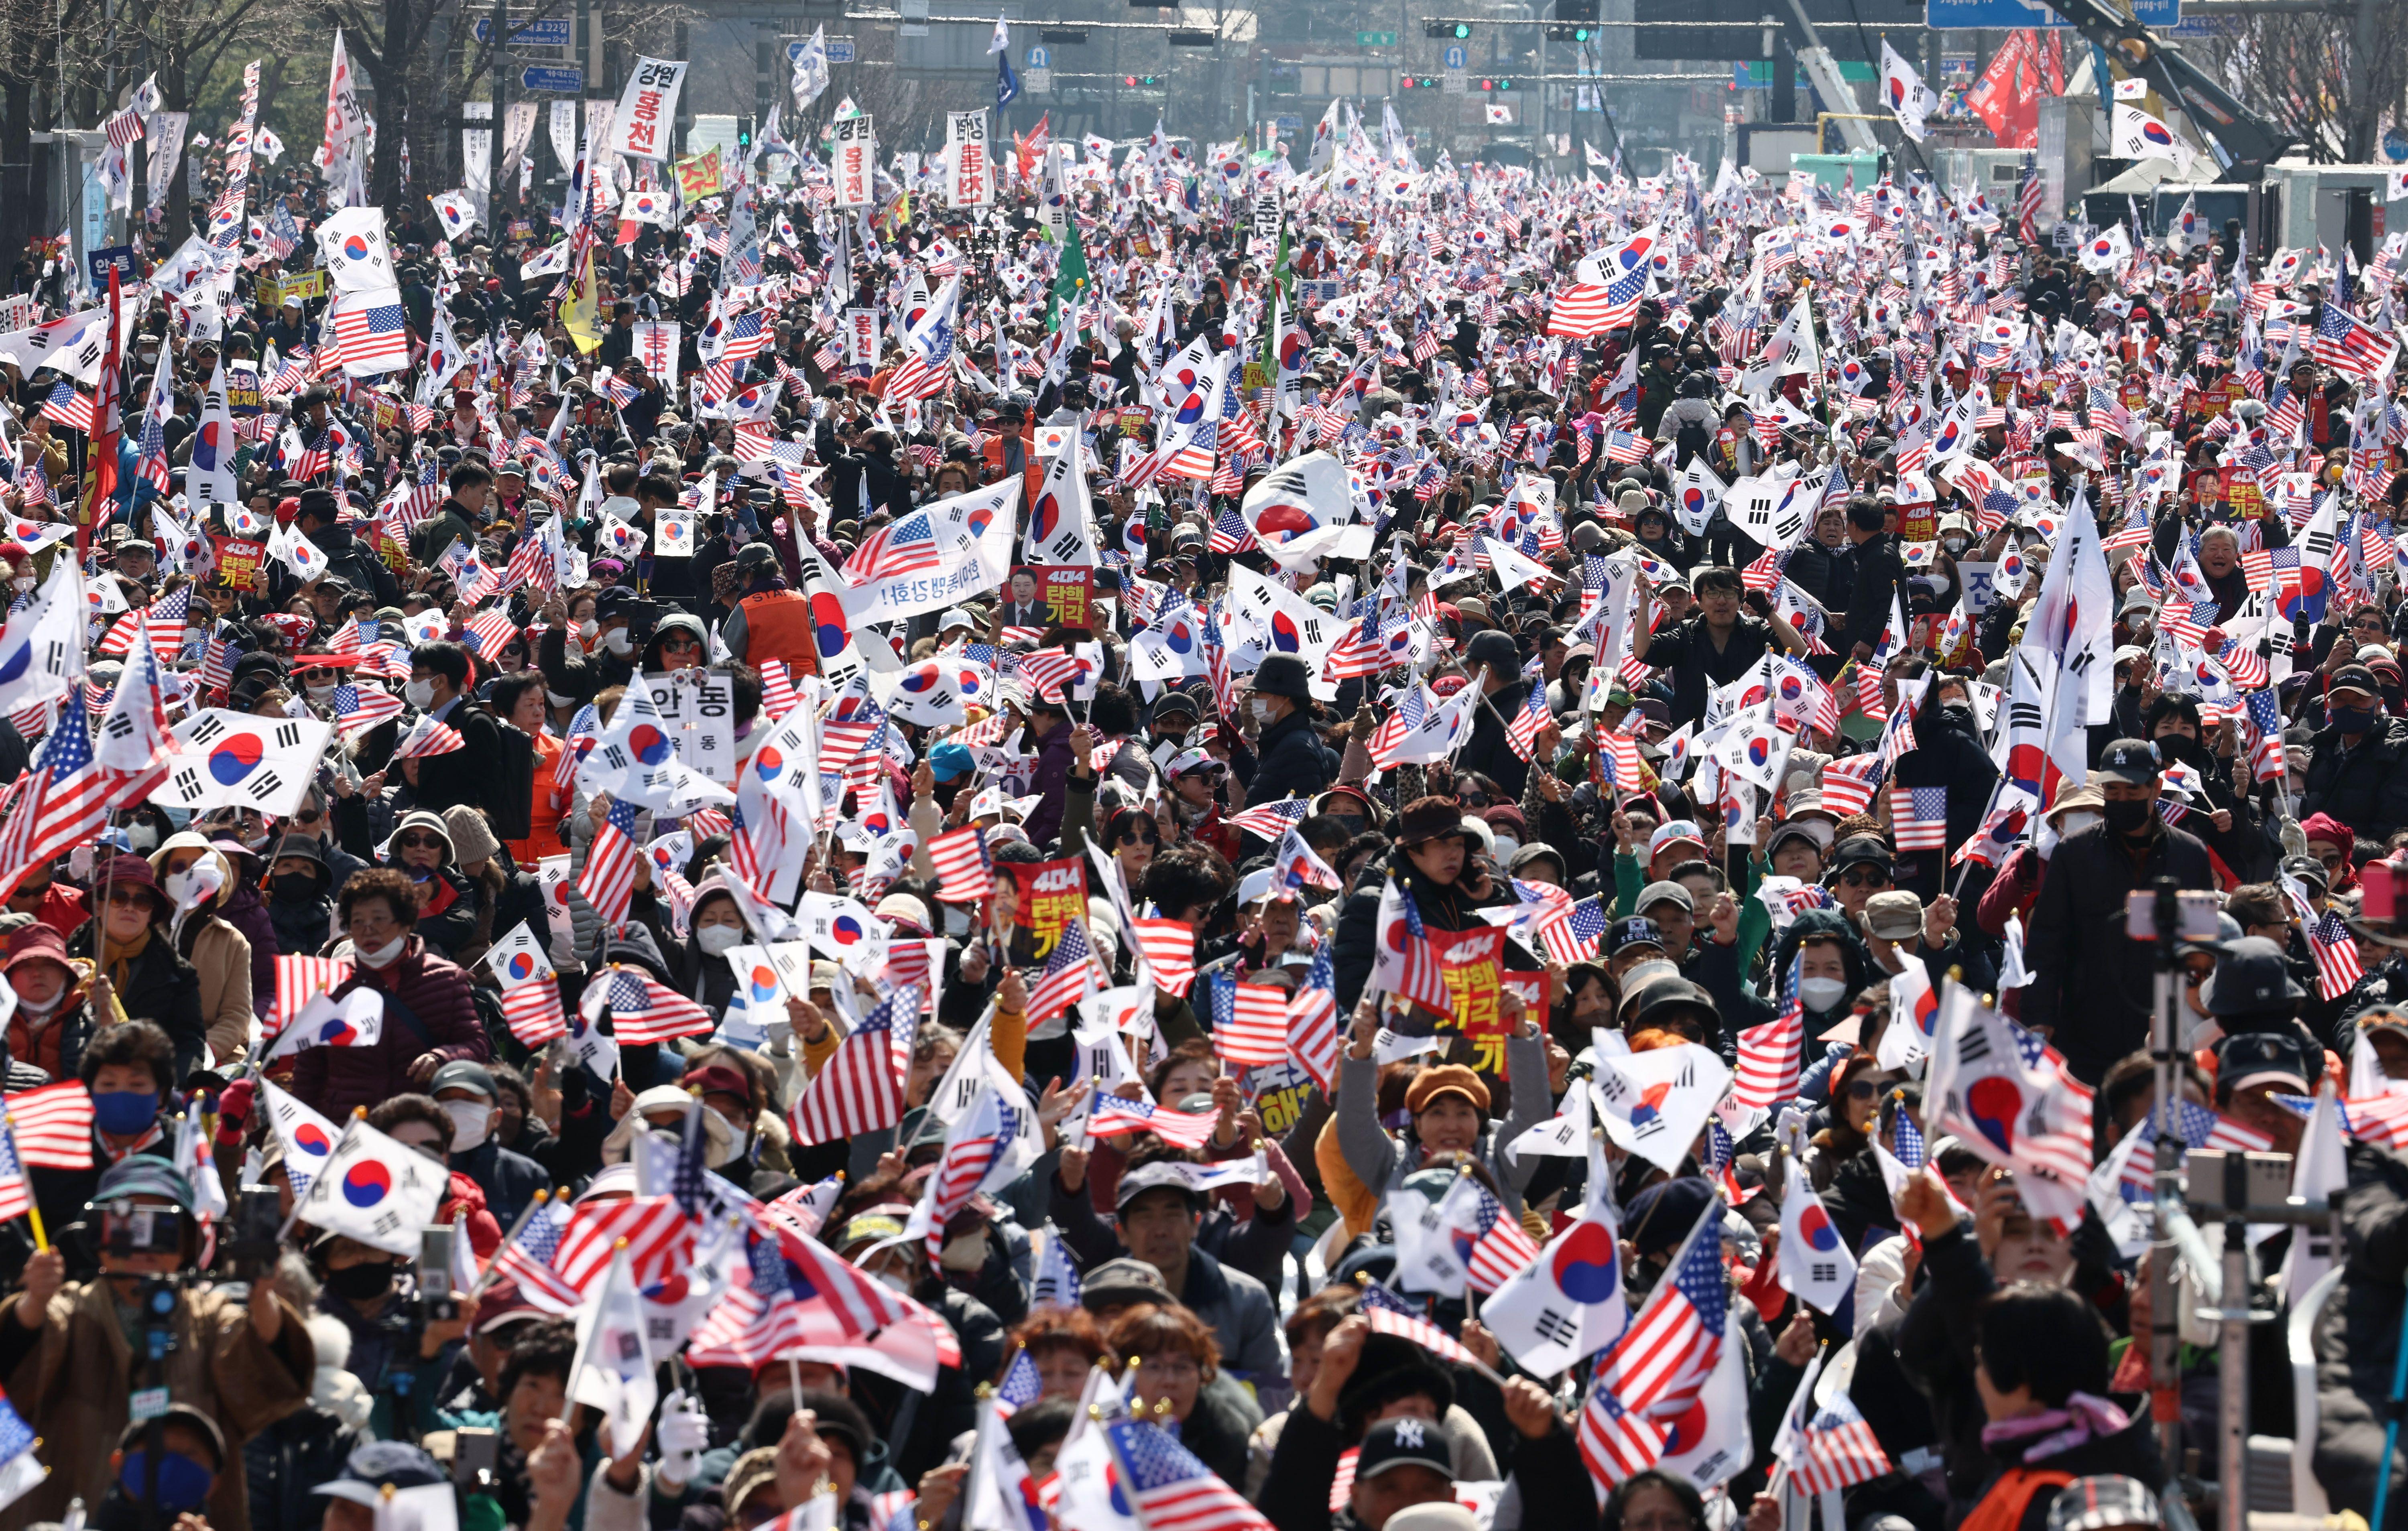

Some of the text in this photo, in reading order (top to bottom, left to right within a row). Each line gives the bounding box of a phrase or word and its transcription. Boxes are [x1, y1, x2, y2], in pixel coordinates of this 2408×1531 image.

[639, 64, 676, 89] 강원
[627, 91, 663, 154] 홍천
[839, 118, 868, 141] 강원
[845, 146, 863, 203] 홍천
[96, 255, 130, 275] 안동
[1302, 283, 1336, 303] 강릉
[12, 303, 26, 331] 풍기
[855, 314, 871, 358] 홍천
[226, 374, 256, 390] 국회
[377, 395, 397, 408] 4대4
[1121, 416, 1145, 426] 탄핵
[1123, 407, 1147, 416] 4대4
[1119, 425, 1141, 438] 기각
[2229, 486, 2263, 502] 탄핵
[1907, 507, 1931, 519] 4대4
[2229, 502, 2264, 518] 기각
[1905, 520, 1932, 535] 탄핵
[224, 542, 258, 557] 4대4
[222, 555, 256, 573] 탄핵
[380, 553, 408, 573] 기각
[219, 571, 252, 589] 기각
[1047, 571, 1086, 583] 4대4
[1046, 586, 1085, 605] 탄핵
[1045, 605, 1085, 624] 기각
[653, 686, 728, 722] 안동
[2114, 748, 2126, 764] LA
[1031, 867, 1081, 892] 4대4
[1034, 928, 1061, 959] 기
[1443, 933, 1495, 963] 4대4
[1394, 1419, 1425, 1449] NY
